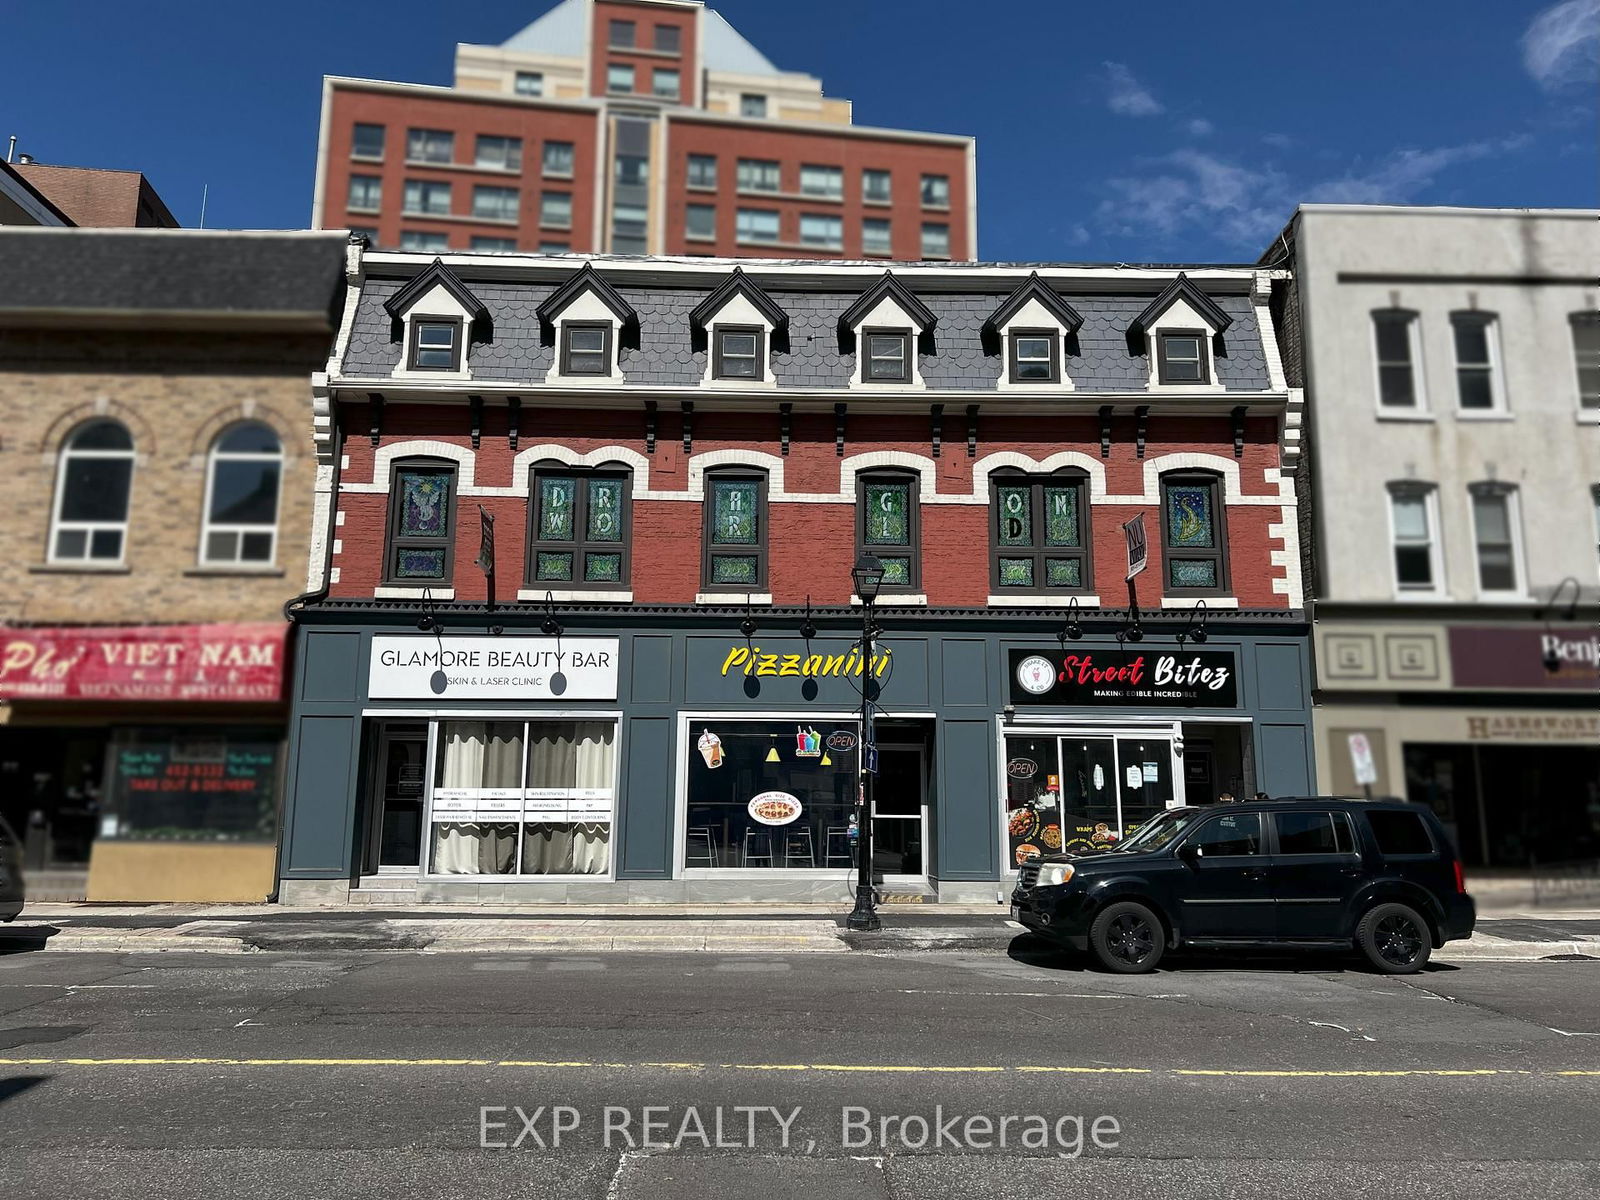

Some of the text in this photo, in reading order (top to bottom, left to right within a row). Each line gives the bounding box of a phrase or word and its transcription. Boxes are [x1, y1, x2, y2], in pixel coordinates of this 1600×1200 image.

[102, 643, 184, 666] VIET
[200, 643, 275, 666] NAM
[381, 650, 610, 668] GLAMORE BEAUTY BAR
[721, 647, 892, 677] Pizzanini
[1059, 655, 1230, 690] Street Bitez
[447, 677, 543, 686] SKIN & LASER CLINIC
[1153, 690, 1198, 698] INCREDIBLE
[828, 735, 856, 748] OPEN
[1008, 762, 1036, 775] OPEN
